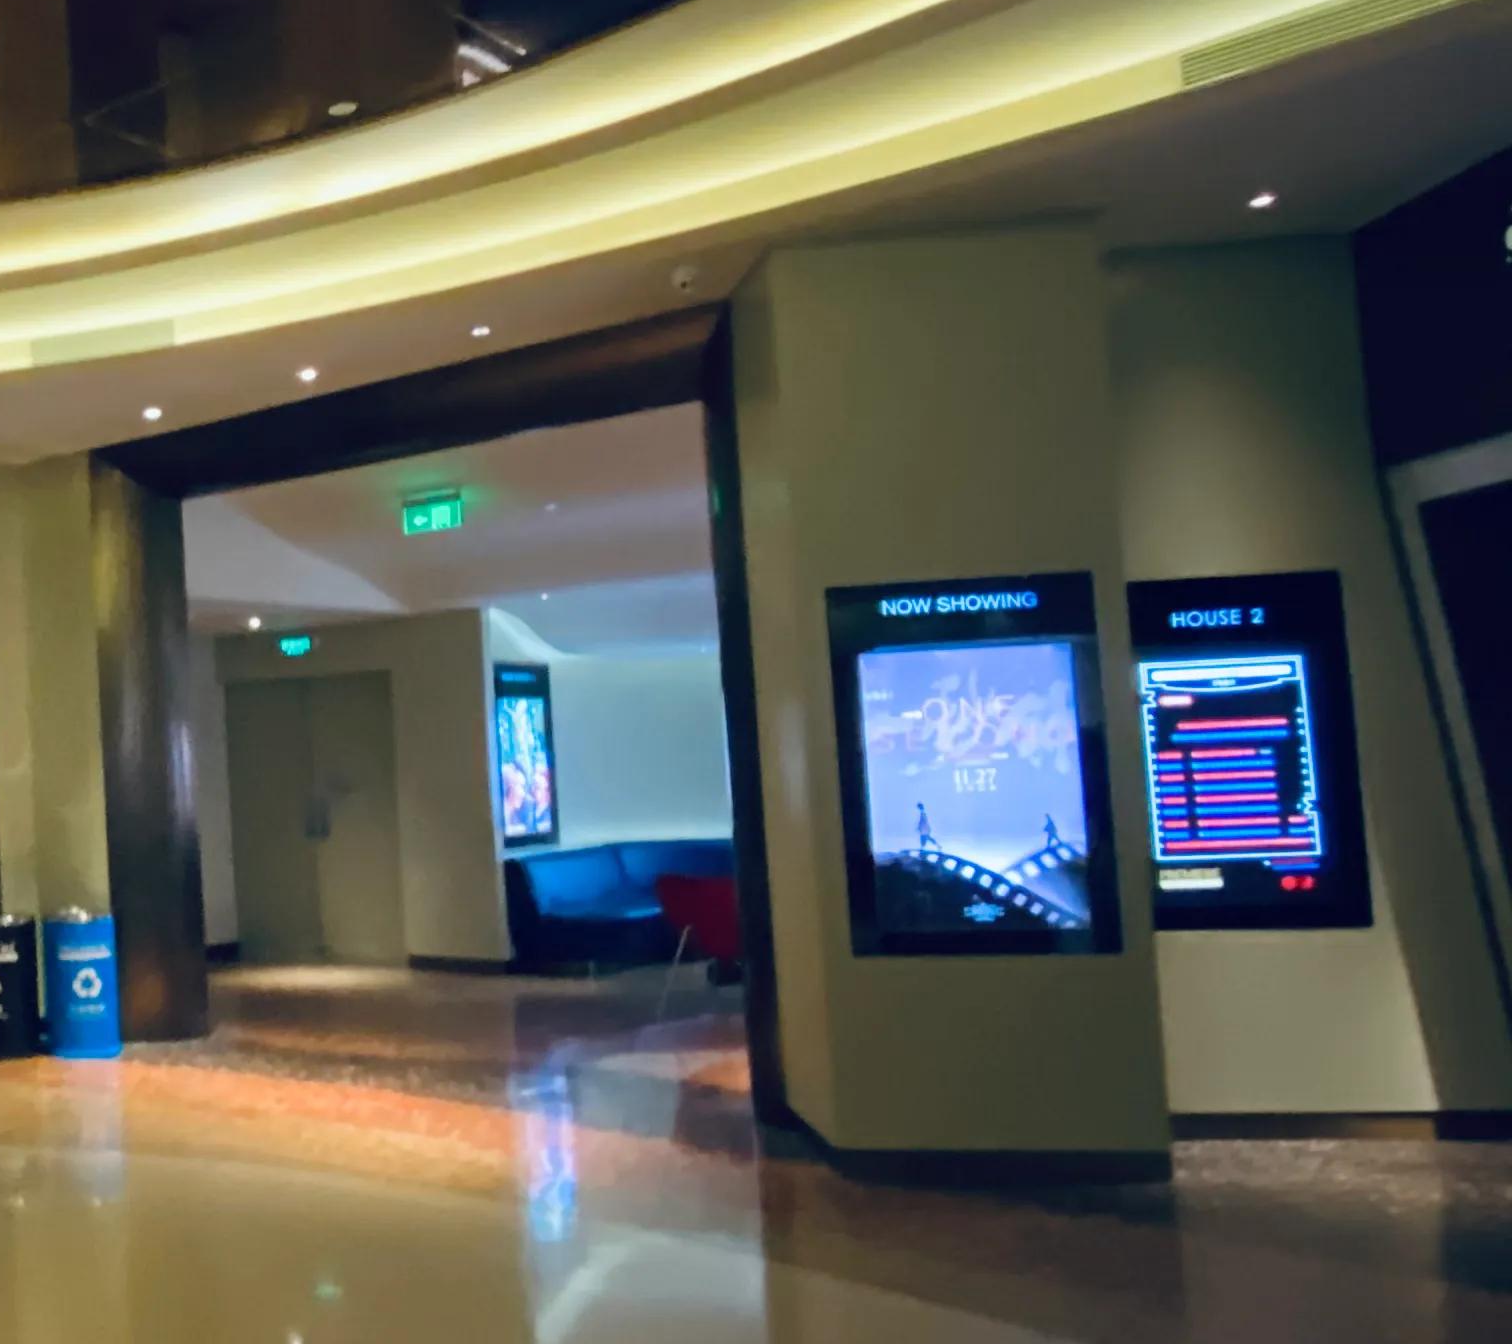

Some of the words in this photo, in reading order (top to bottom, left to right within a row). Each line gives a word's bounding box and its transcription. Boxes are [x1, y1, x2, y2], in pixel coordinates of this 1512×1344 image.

[880, 596, 931, 616] NOW
[936, 591, 1038, 613] SHOWING
[1171, 608, 1242, 628] HOUSE
[1249, 607, 1264, 625] 2
